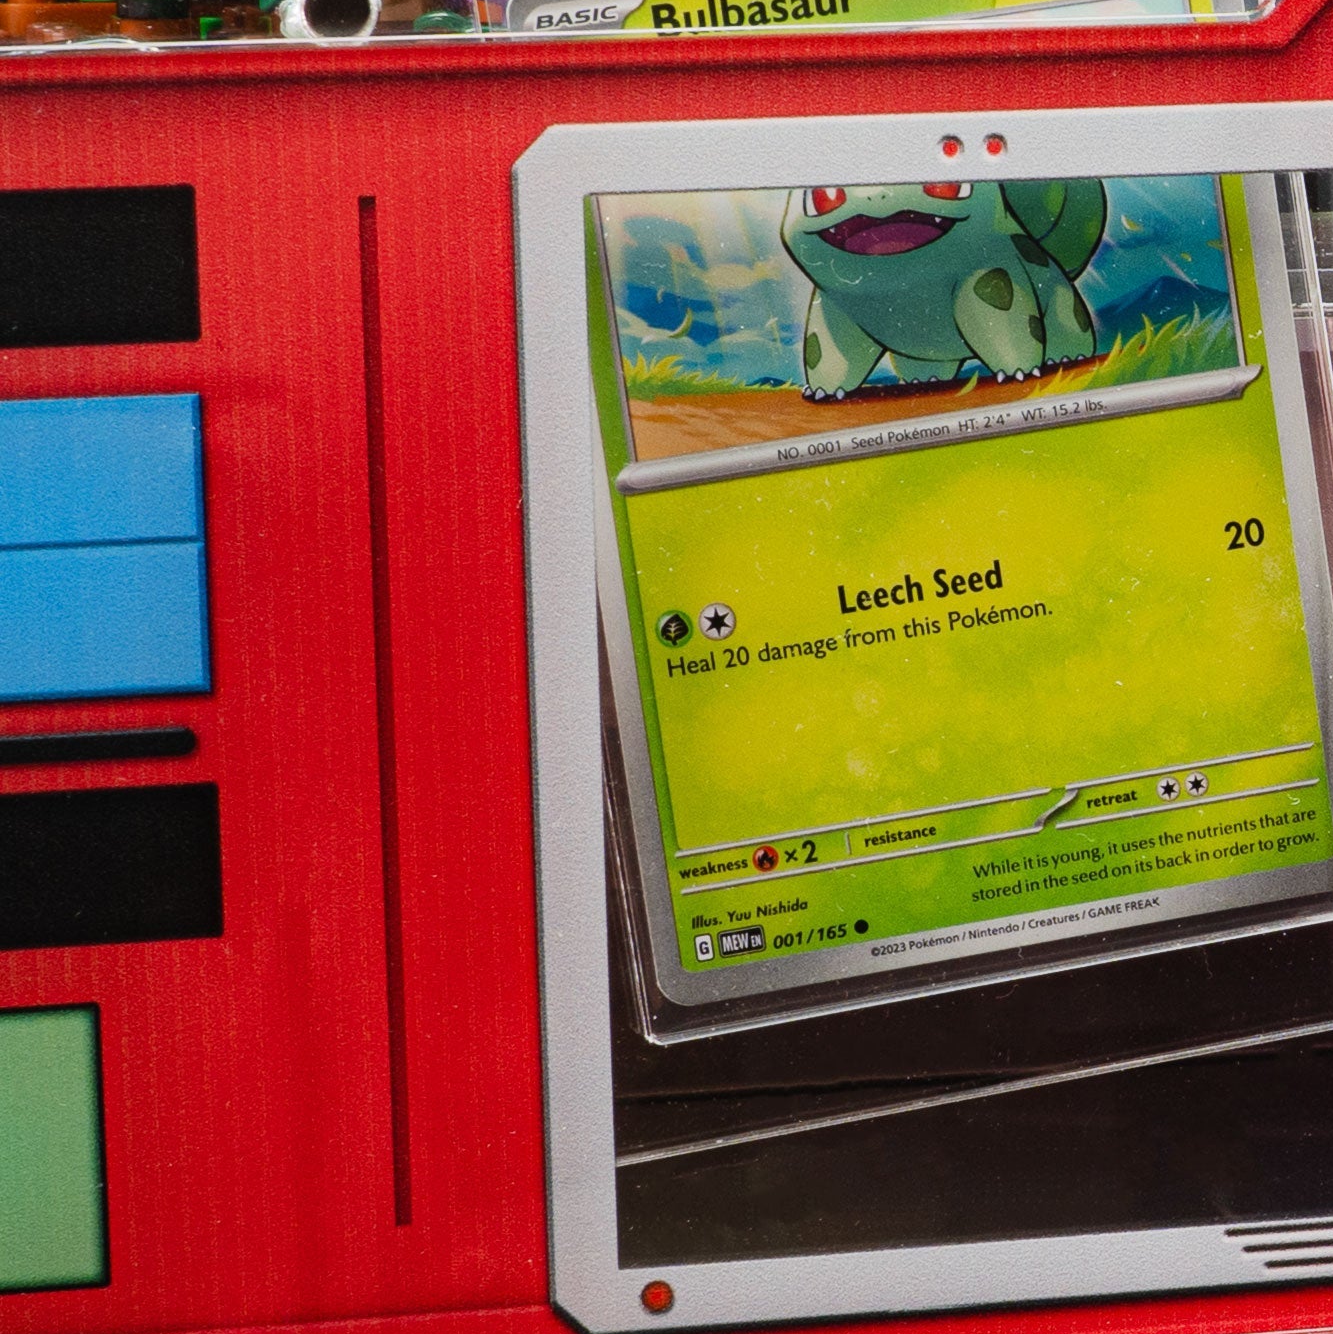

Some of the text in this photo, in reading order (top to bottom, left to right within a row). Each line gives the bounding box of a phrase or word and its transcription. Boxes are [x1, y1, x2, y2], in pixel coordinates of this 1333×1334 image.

[536, 3, 618, 28] BASIC
[778, 446, 803, 462] NO.
[808, 440, 842, 456] 0001
[852, 433, 883, 450] Seed
[888, 424, 950, 446] Pokémon
[958, 418, 978, 432] HT:
[1022, 407, 1048, 422] WT:
[1052, 401, 1081, 417] 15.2
[1085, 397, 1107, 412] lbs.
[838, 518, 1265, 614] Leech Seed 20
[667, 599, 1053, 678] Heal 20 damage from this Pokémon.
[679, 790, 1137, 879] weakness resistance retreat
[972, 833, 1320, 902] stored in the seed on its back in order to grow.
[973, 809, 1316, 878] While it is young, it uses the nutrients that are
[691, 898, 808, 929] Illus. Yuu Nishida
[909, 931, 959, 949] Pokémon
[968, 923, 1019, 941] Nintendo
[1028, 911, 1080, 930] Creatures
[1088, 903, 1122, 918] GAME
[1125, 897, 1160, 913] FREAK
[699, 940, 709, 955] G
